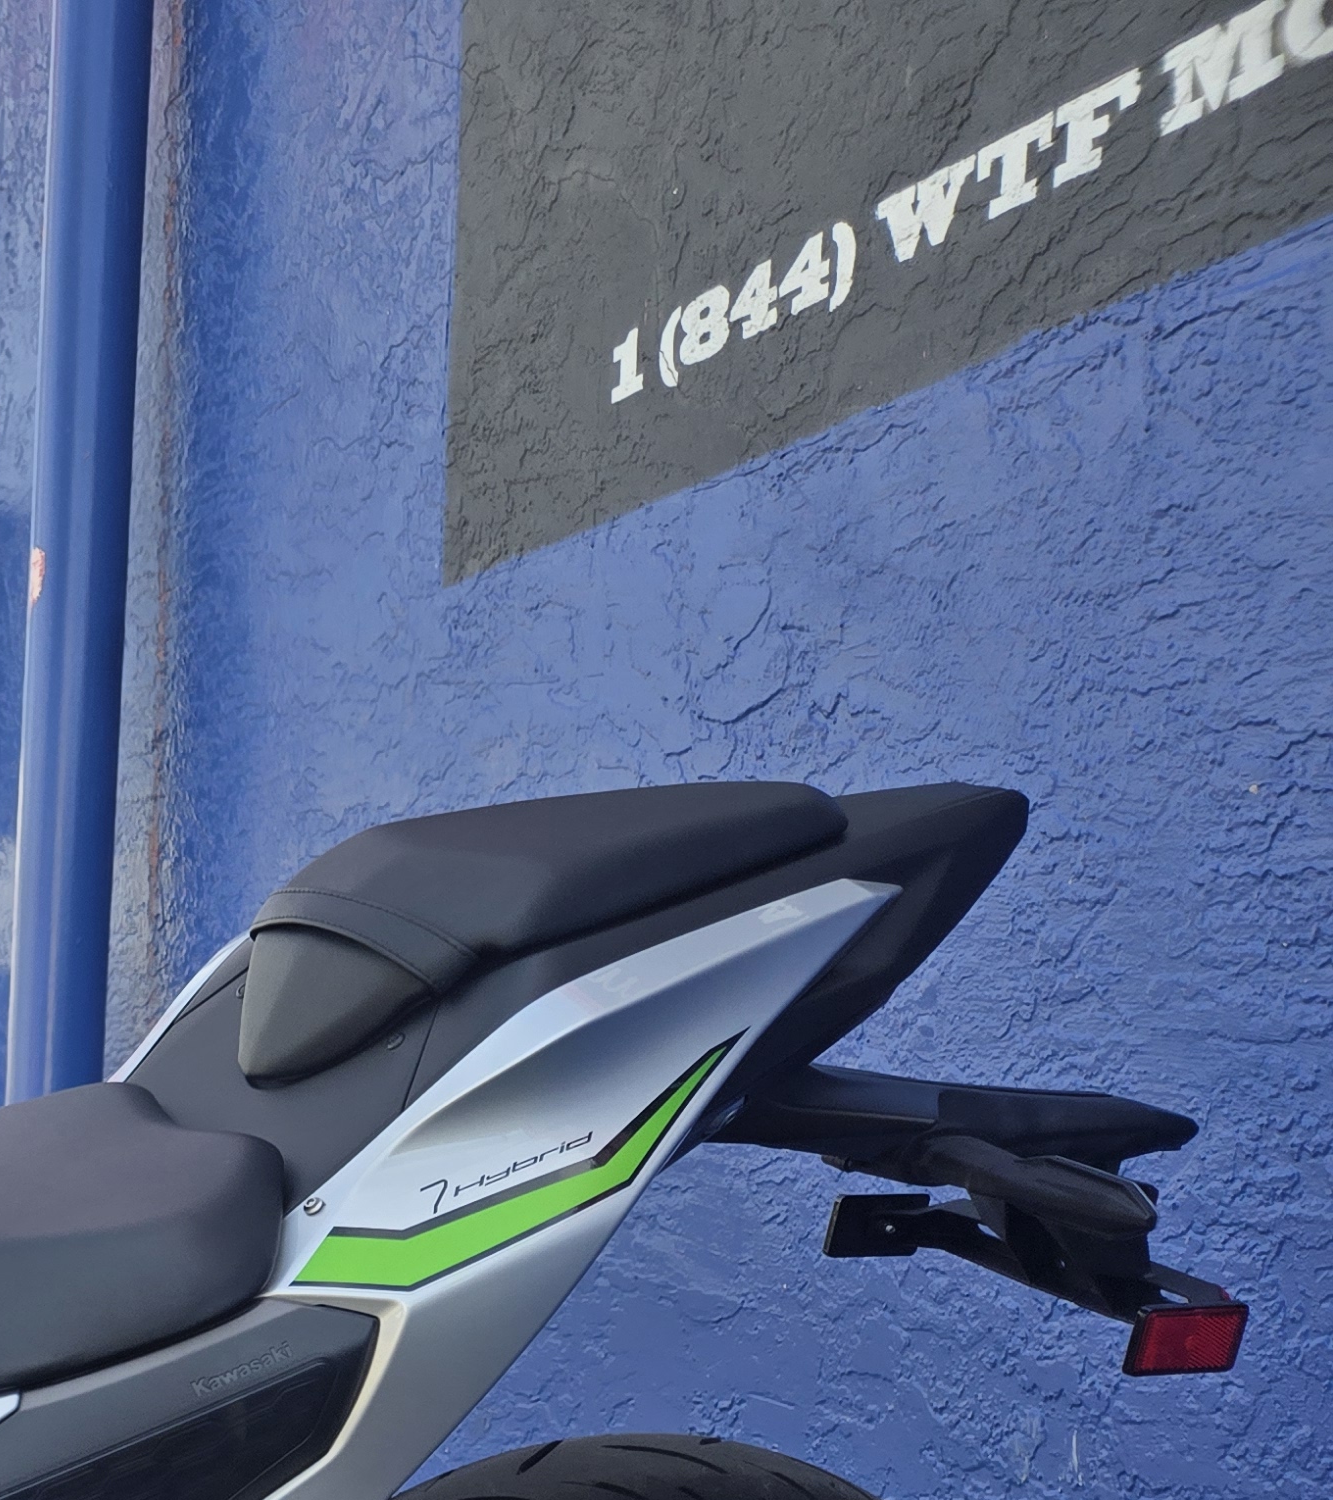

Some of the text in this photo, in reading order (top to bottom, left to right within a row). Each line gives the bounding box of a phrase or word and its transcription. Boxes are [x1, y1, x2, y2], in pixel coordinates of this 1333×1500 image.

[875, 67, 1141, 263] WTF
[453, 1131, 593, 1197] Hybrid
[190, 1341, 294, 1397] Kawasaki
